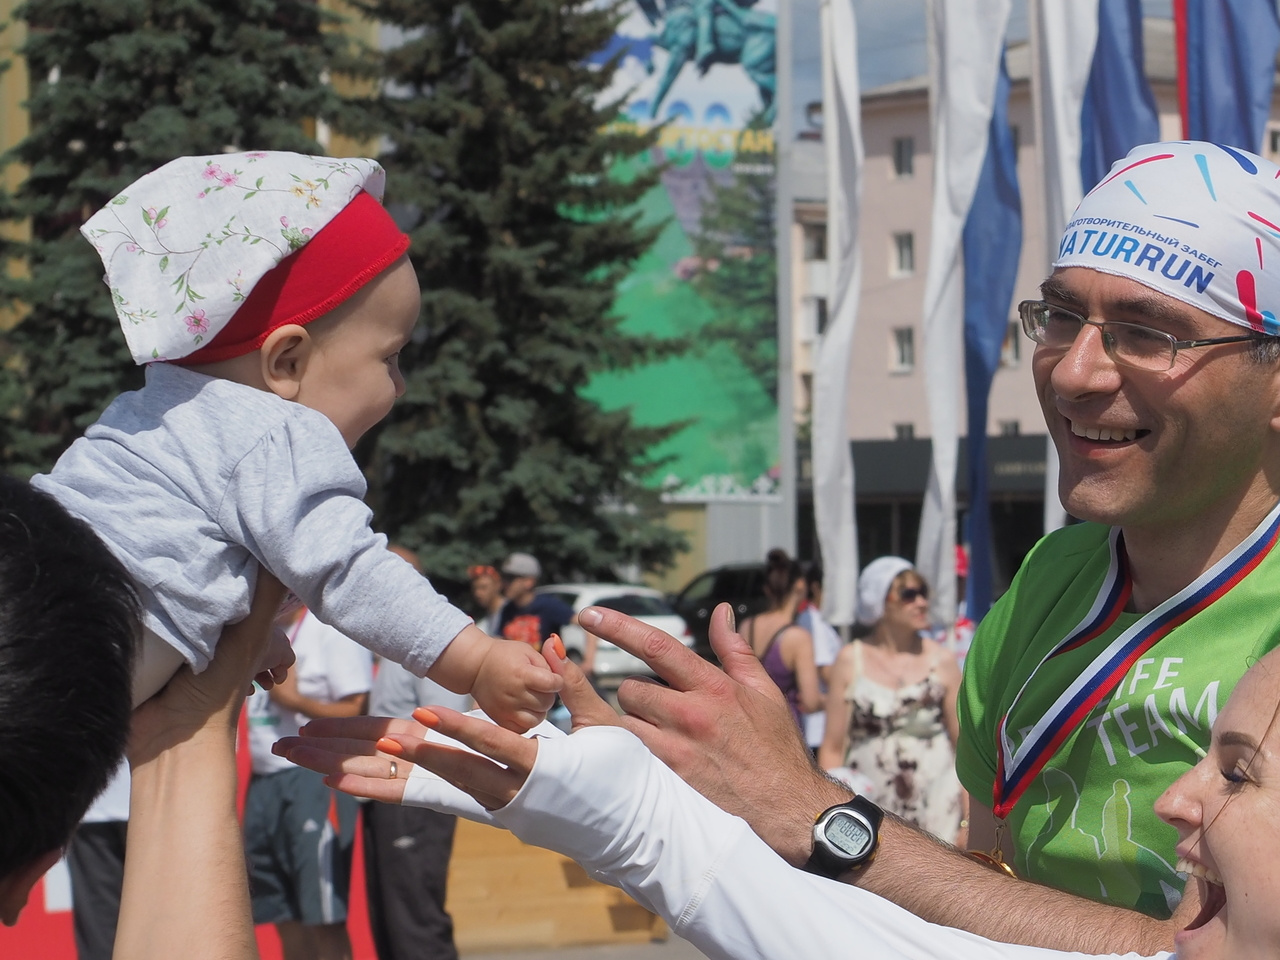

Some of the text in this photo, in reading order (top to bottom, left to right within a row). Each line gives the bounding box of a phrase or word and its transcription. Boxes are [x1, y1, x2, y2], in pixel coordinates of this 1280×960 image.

[1058, 229, 1215, 294] NATURRUN
[1064, 217, 1223, 269] ЛАГОТВОРИТЕЛЬНЫЙ ЗАБЕГ
[1086, 680, 1220, 766] TEAM
